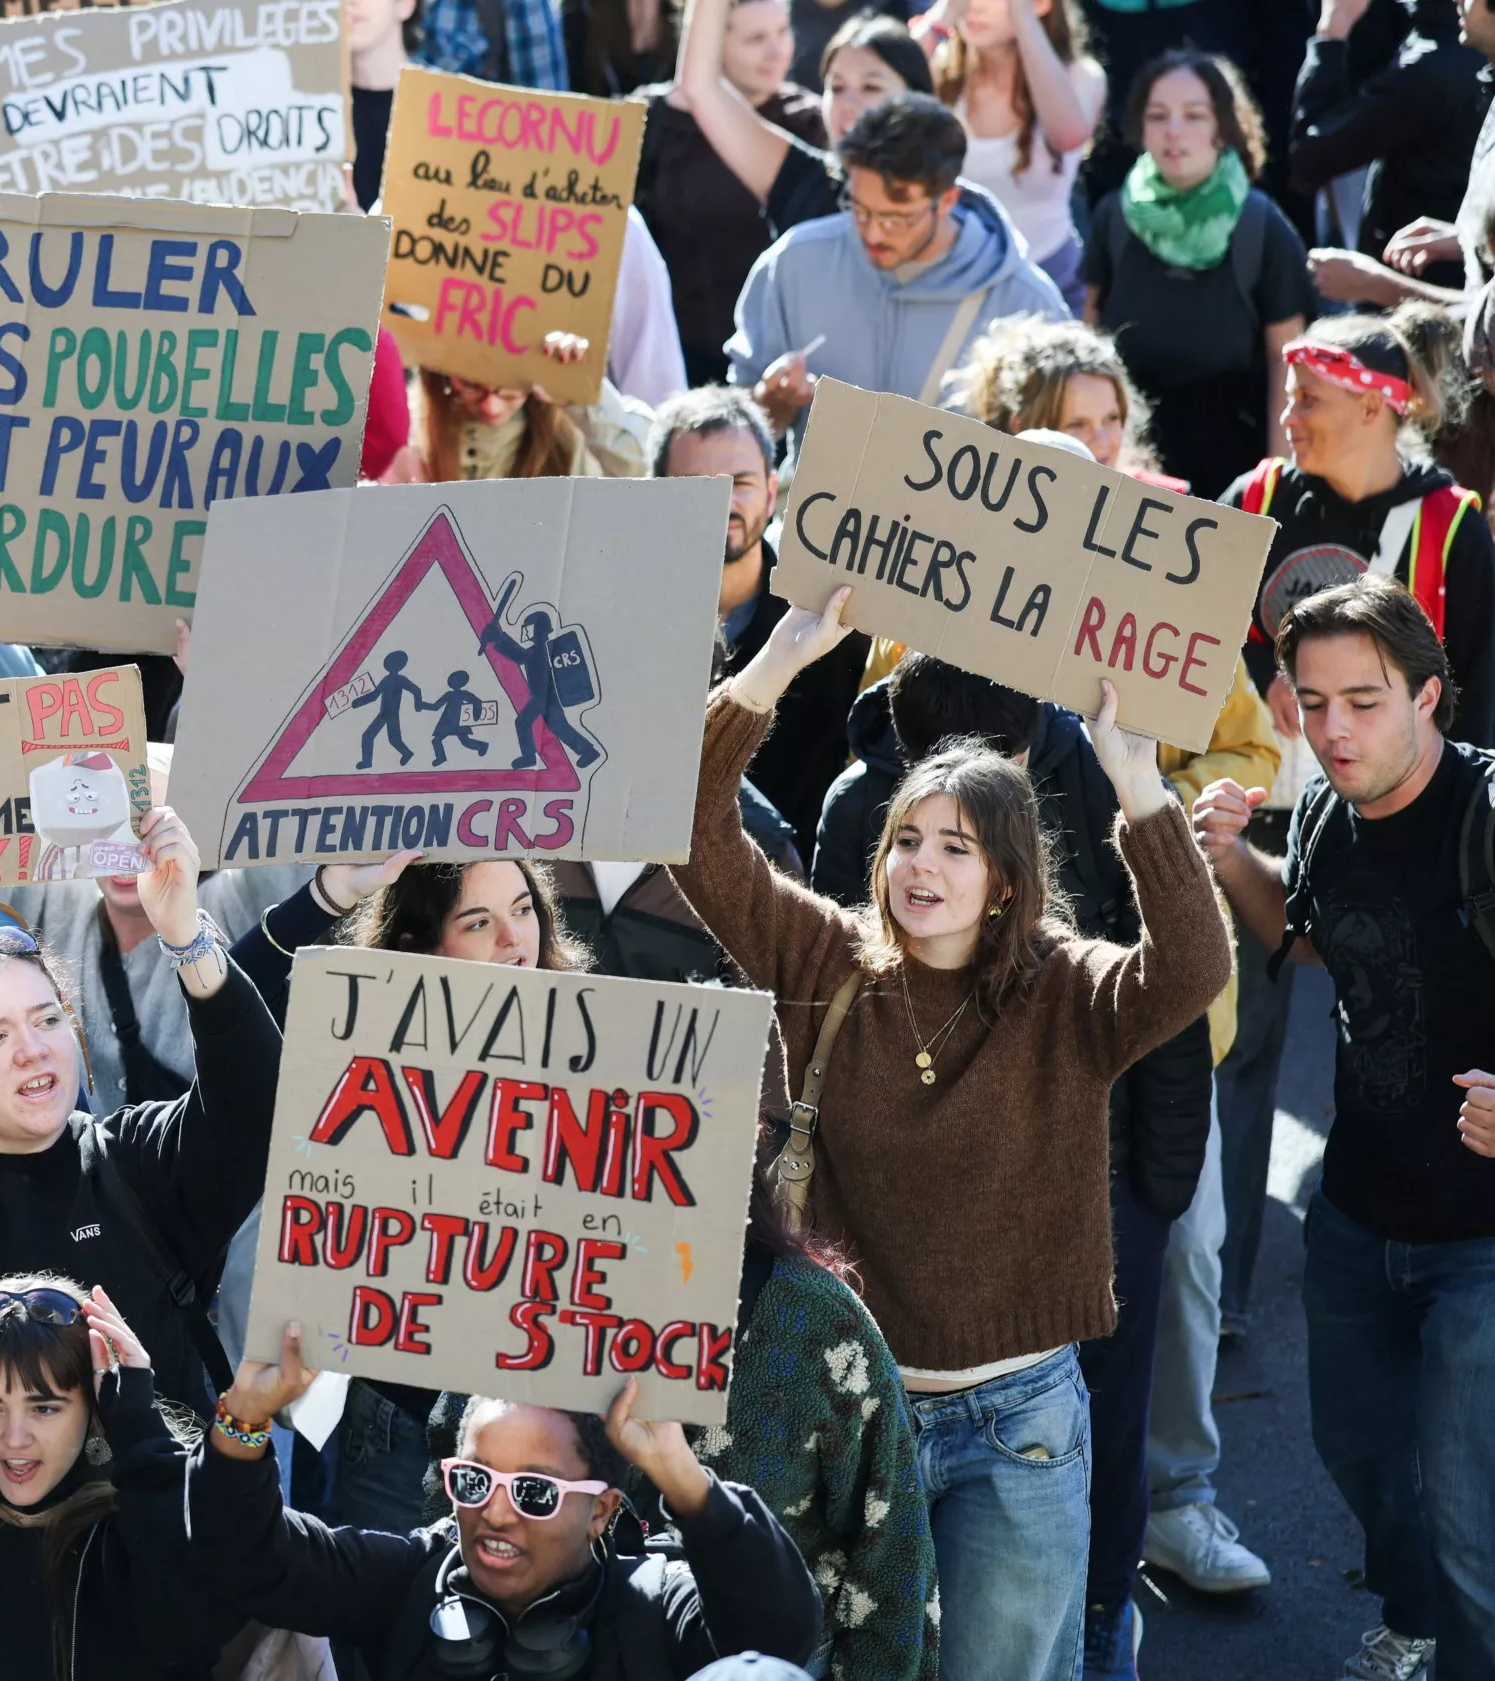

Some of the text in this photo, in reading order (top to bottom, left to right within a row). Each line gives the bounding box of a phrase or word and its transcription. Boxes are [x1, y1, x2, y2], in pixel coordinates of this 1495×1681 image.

[2, 65, 229, 137] DEVRAIENT
[427, 92, 621, 166] LECORNU
[108, 117, 205, 176] DES
[217, 105, 337, 154] DROITS
[413, 160, 454, 186] au
[466, 150, 512, 194] lieu
[393, 230, 591, 297] DONNE DU
[427, 199, 604, 261] des SLIPS
[434, 276, 537, 356] FRIC
[43, 327, 373, 427] POUBELLES
[40, 415, 200, 510] PEUR
[204, 427, 343, 511] AUX
[904, 429, 1219, 585] SOUS LES
[553, 649, 581, 669] CRS
[990, 566, 1052, 638] LA
[1074, 596, 1221, 696] RAGE
[26, 672, 125, 740] PAS
[328, 677, 372, 710] 1312
[129, 764, 151, 812] 1312
[94, 852, 142, 869] OPEN
[224, 798, 574, 861] ATTENTION CRS
[325, 969, 721, 1090] J'AVAIS UN
[70, 1224, 101, 1242] VANS
[288, 1168, 623, 1236] mais il était en
[277, 1195, 627, 1311] RUPTURE
[347, 1285, 734, 1392] DE STOCK
